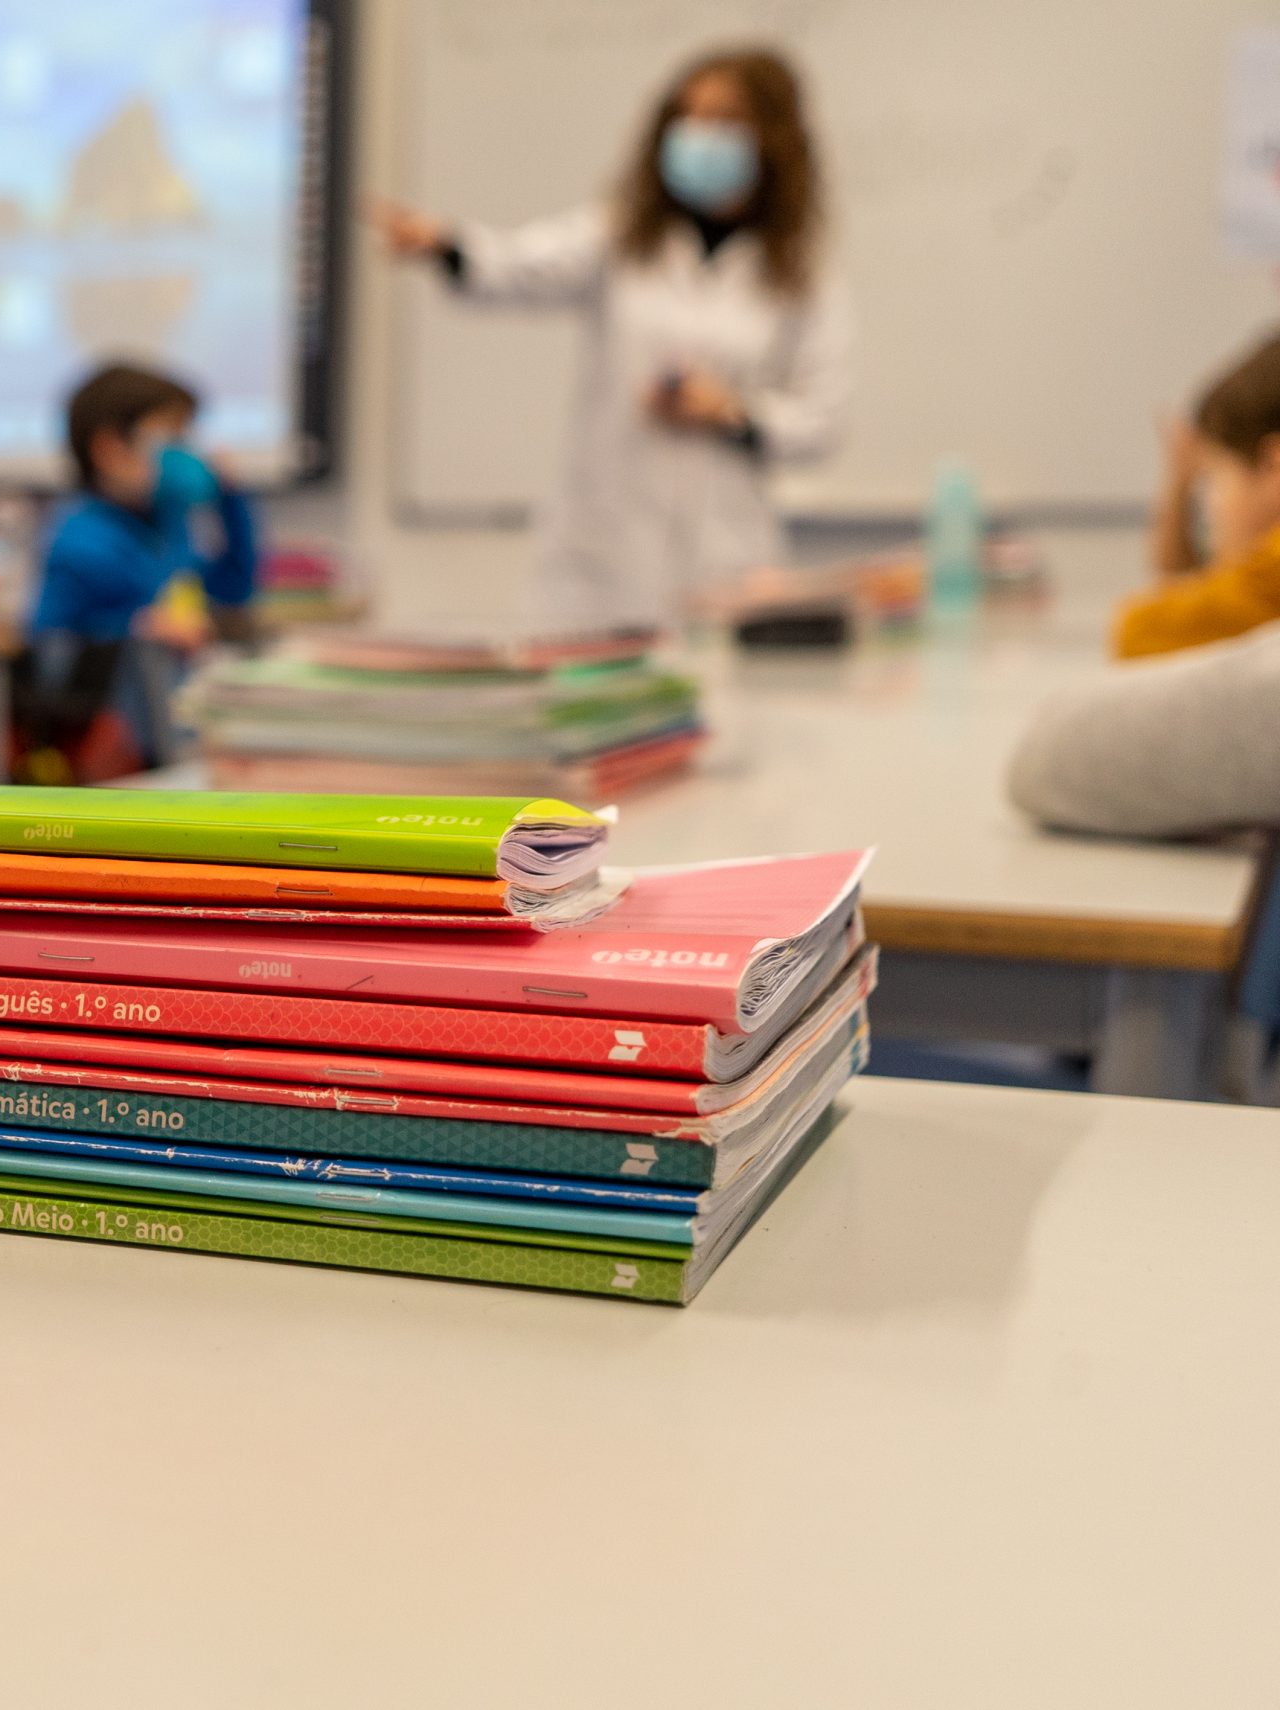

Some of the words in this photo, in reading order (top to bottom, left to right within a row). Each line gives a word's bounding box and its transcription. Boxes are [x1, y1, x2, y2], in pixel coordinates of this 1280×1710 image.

[113, 1002, 161, 1022] ano
[136, 1108, 184, 1130] ano
[11, 1202, 74, 1231] Meio
[135, 1221, 184, 1243] ano
